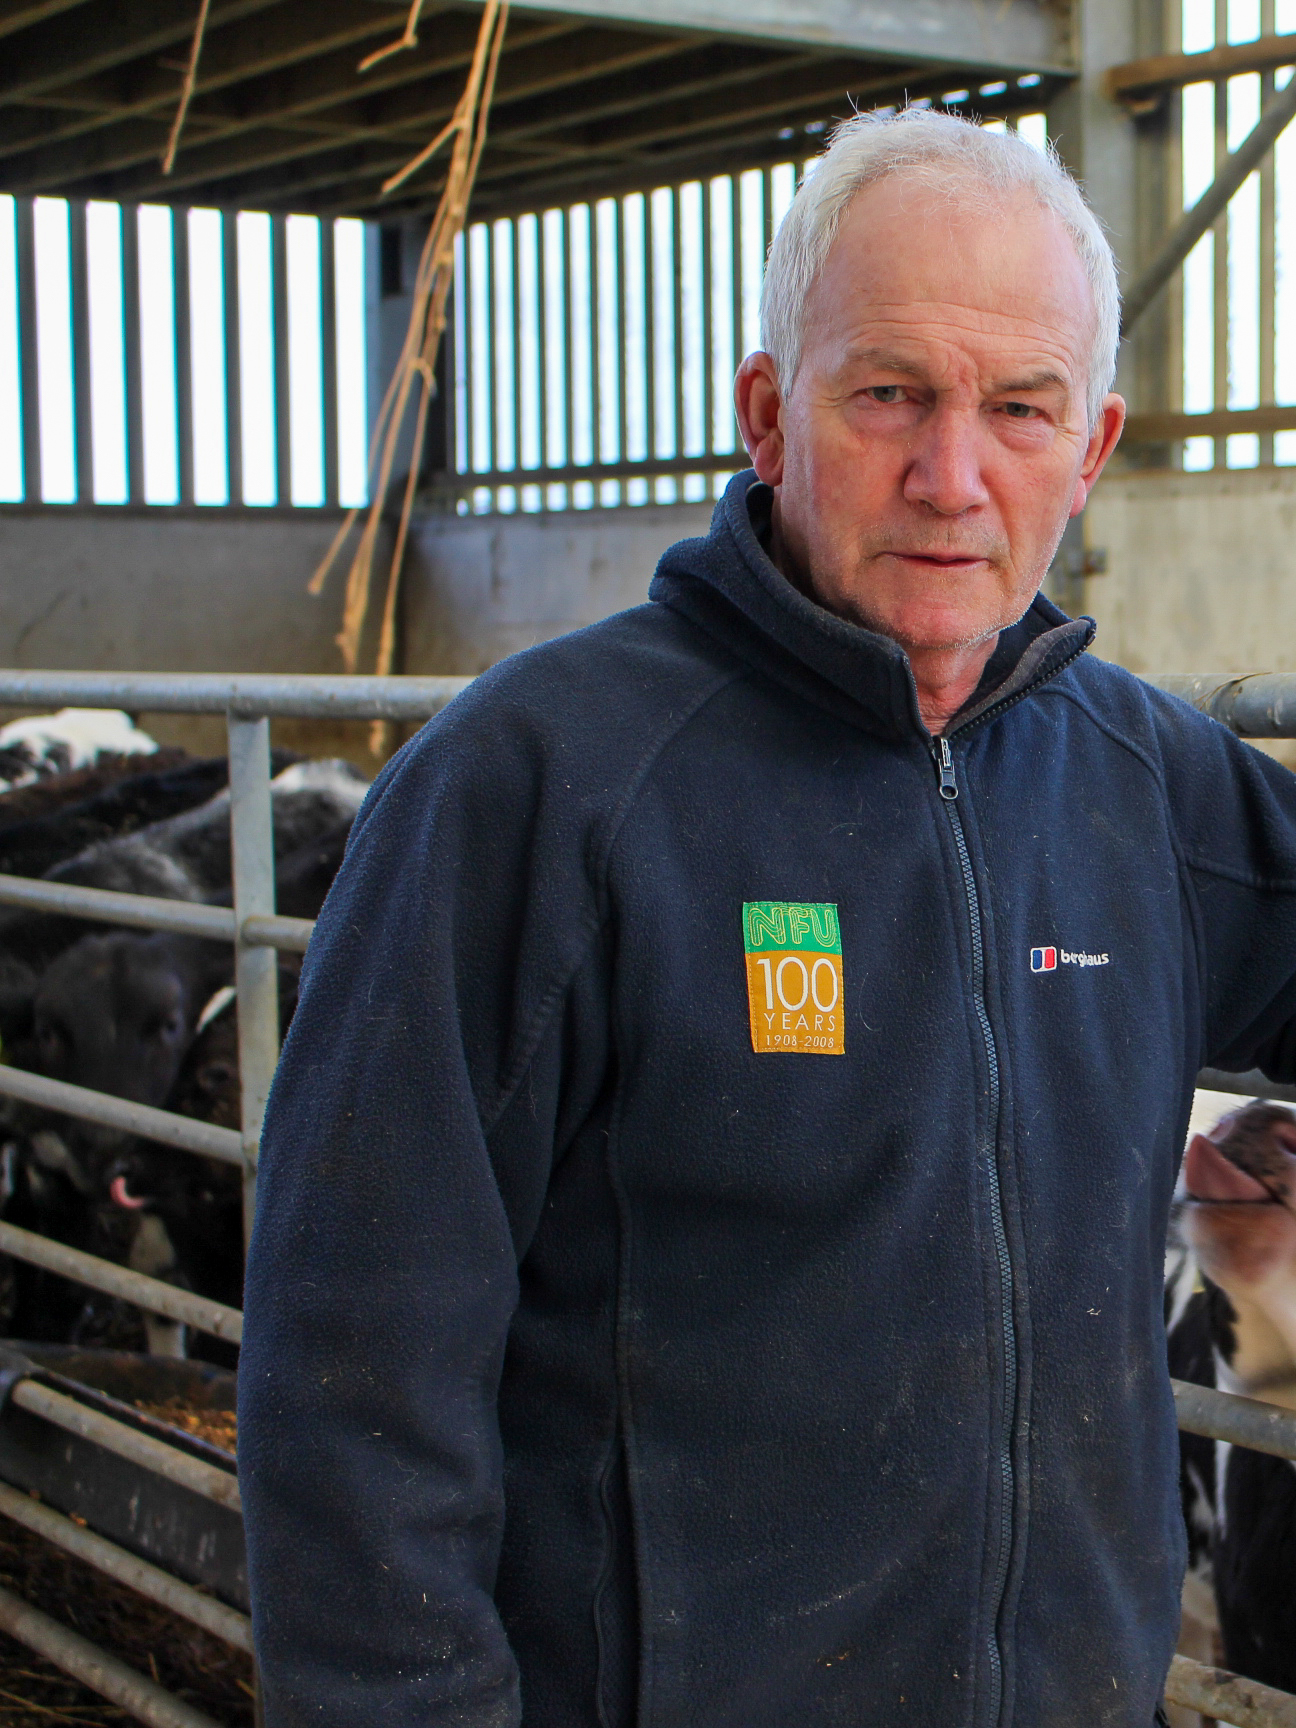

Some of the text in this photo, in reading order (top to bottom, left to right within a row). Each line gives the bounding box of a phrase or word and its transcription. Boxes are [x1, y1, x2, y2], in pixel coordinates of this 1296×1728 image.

[750, 907, 837, 947] NFU
[757, 956, 839, 1012] 100
[763, 1012, 836, 1032] YEARS
[766, 1034, 835, 1048] 1908-2008
